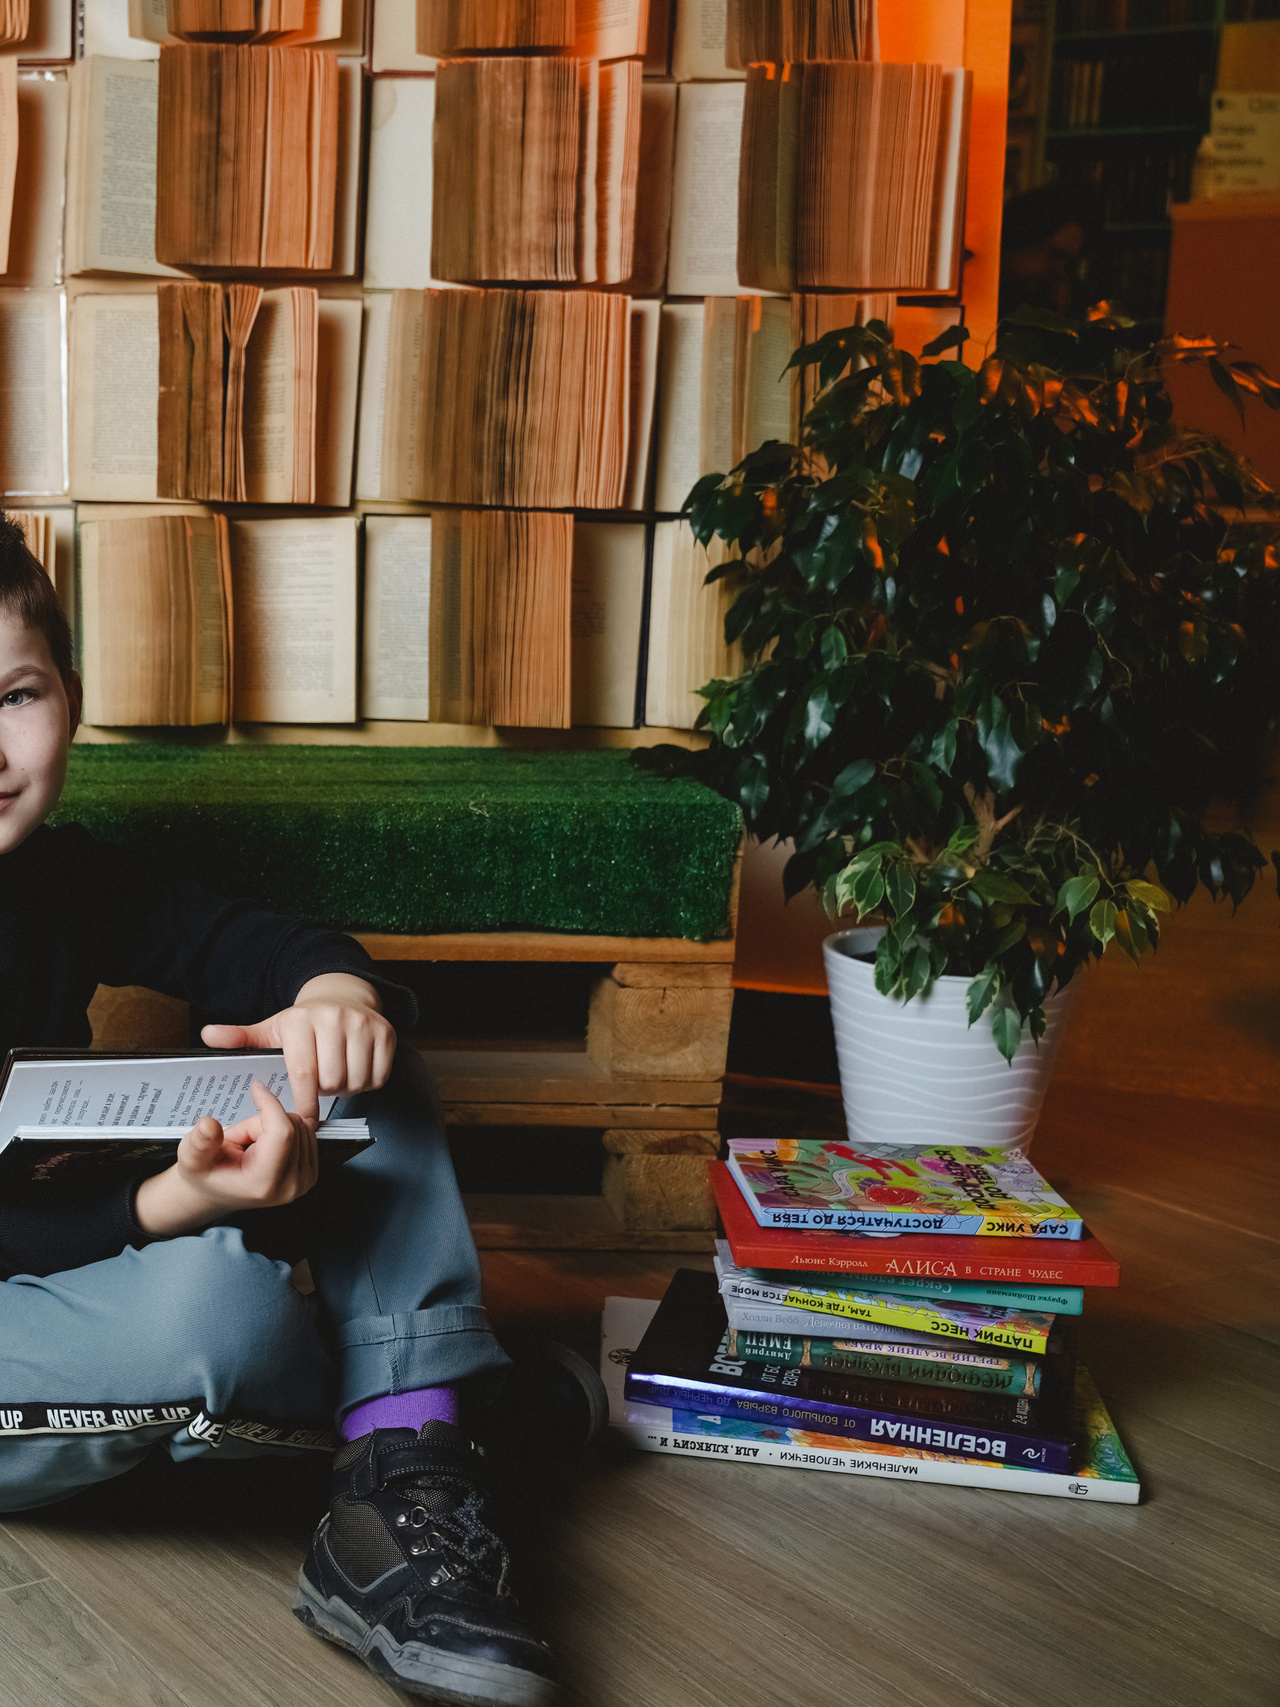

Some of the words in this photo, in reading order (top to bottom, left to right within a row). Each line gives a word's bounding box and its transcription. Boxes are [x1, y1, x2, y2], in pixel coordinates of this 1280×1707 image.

[772, 1212, 809, 1224] ТЕБЯ
[813, 1213, 834, 1225] ДО
[837, 1215, 944, 1231] ДОСТУЧАТЬСЯ
[986, 1219, 1027, 1234] УИКС
[1029, 1220, 1069, 1235] САРА
[791, 1255, 826, 1266] Льюис
[828, 1257, 868, 1268] Кэрролл
[885, 1258, 957, 1277] АЛИСА
[979, 1266, 1021, 1277] СТРАНЕ
[1028, 1269, 1063, 1280] ЧУДЕС
[731, 1285, 760, 1297] МОРЕ
[898, 1276, 952, 1294] Секрет
[762, 1291, 825, 1308] КОНЧАЕТСЯ
[826, 1303, 845, 1313] ГДЕ
[847, 1306, 872, 1318] ТАМ,
[742, 1312, 774, 1323] Холли
[775, 1314, 799, 1324] Вебб
[804, 1315, 851, 1330] Девочка
[853, 1322, 866, 1331] из
[930, 1320, 970, 1337] НЕСС
[842, 1341, 883, 1351] МРАКА
[973, 1328, 1033, 1349] ПАТРИК
[745, 1348, 792, 1361] Дмитрий
[887, 1346, 947, 1361] ВСАДНИК
[952, 1354, 1002, 1367] ТРЕТИЙ
[736, 1400, 779, 1415] ВЗРЫВА
[0, 1409, 24, 1431] UP
[46, 1407, 108, 1430] NEVER
[111, 1407, 160, 1428] GIVE
[162, 1406, 191, 1421] UP
[782, 1408, 839, 1426] БОЛЬШОГО
[843, 1419, 856, 1429] ОТ
[870, 1418, 1008, 1458] ВСЕЛЕННАЯ
[780, 1451, 846, 1467] ЧЕЛОВЕЧКИ
[849, 1458, 918, 1475] МАЛЕНЬКИЕ
